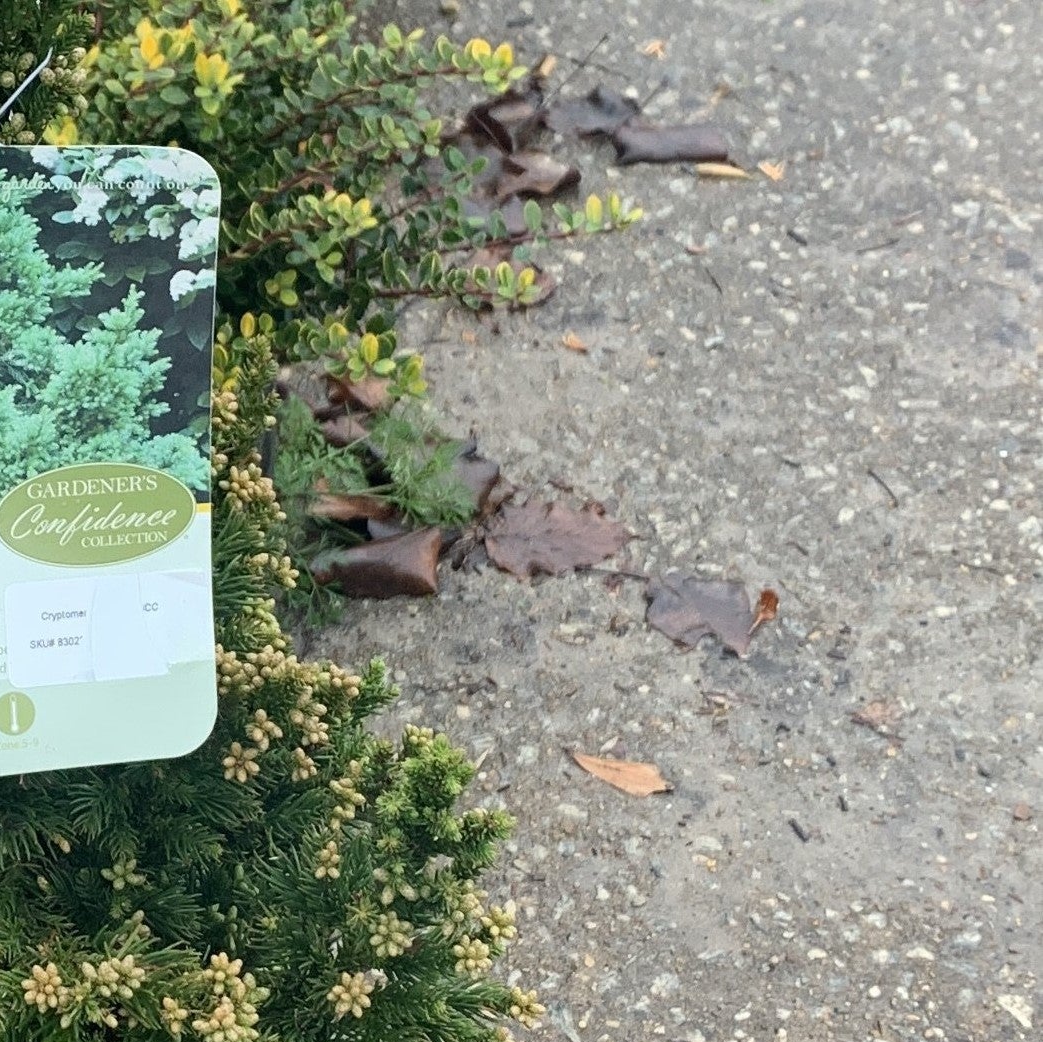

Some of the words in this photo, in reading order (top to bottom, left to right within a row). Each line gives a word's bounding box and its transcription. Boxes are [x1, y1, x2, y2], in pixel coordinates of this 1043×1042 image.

[27, 474, 157, 499] GARDENER'S
[10, 502, 177, 546] Confidence
[81, 531, 168, 548] COLLECTION
[29, 639, 55, 649] SKU#
